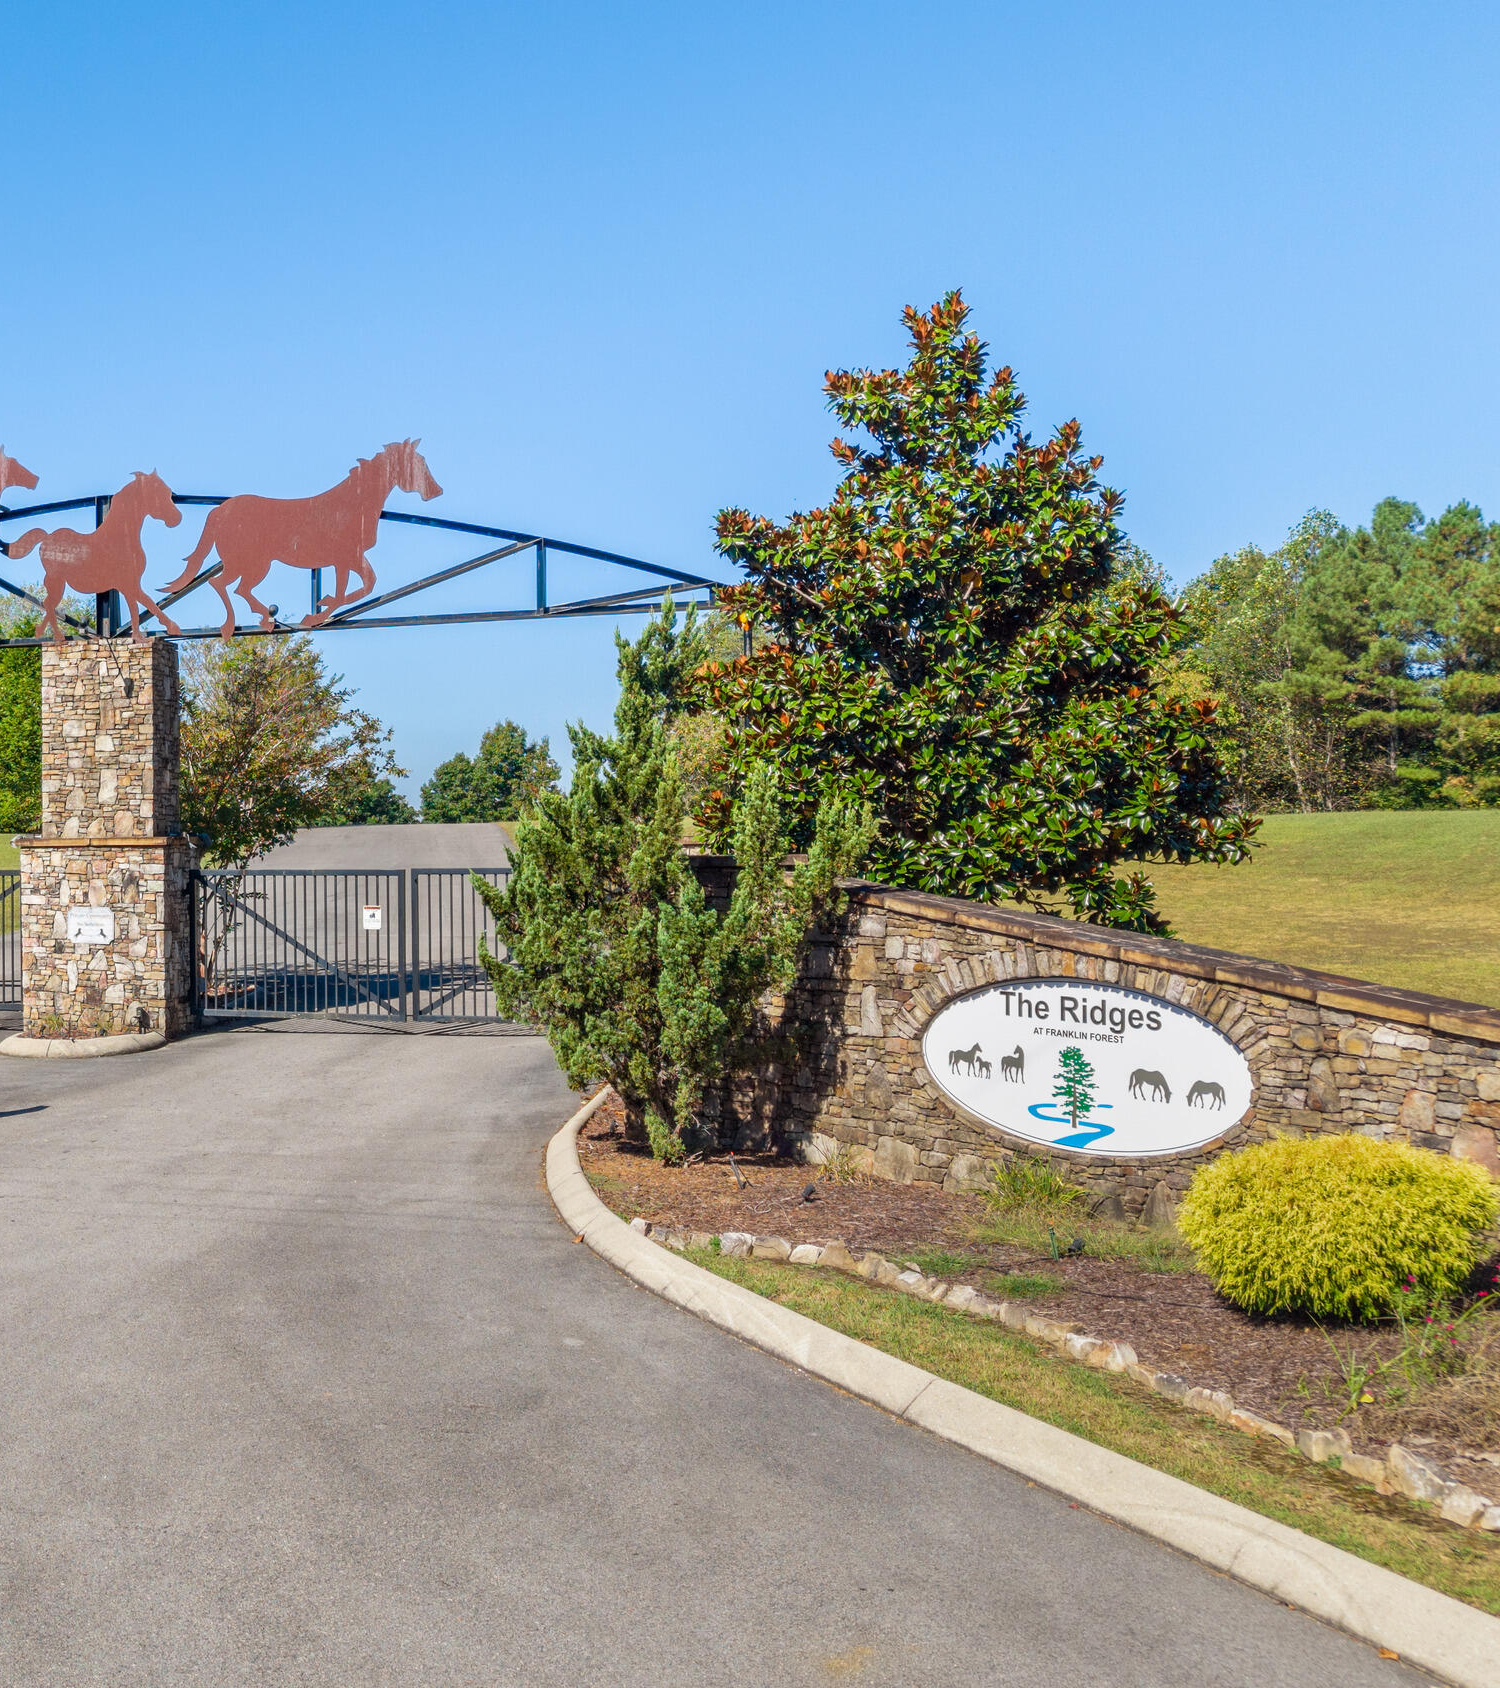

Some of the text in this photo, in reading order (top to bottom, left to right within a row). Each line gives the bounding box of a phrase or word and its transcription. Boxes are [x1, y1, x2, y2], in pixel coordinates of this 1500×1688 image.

[999, 990, 1163, 1035] The Ridges
[1033, 1026, 1125, 1044] AT FRANKLIN FOREST
